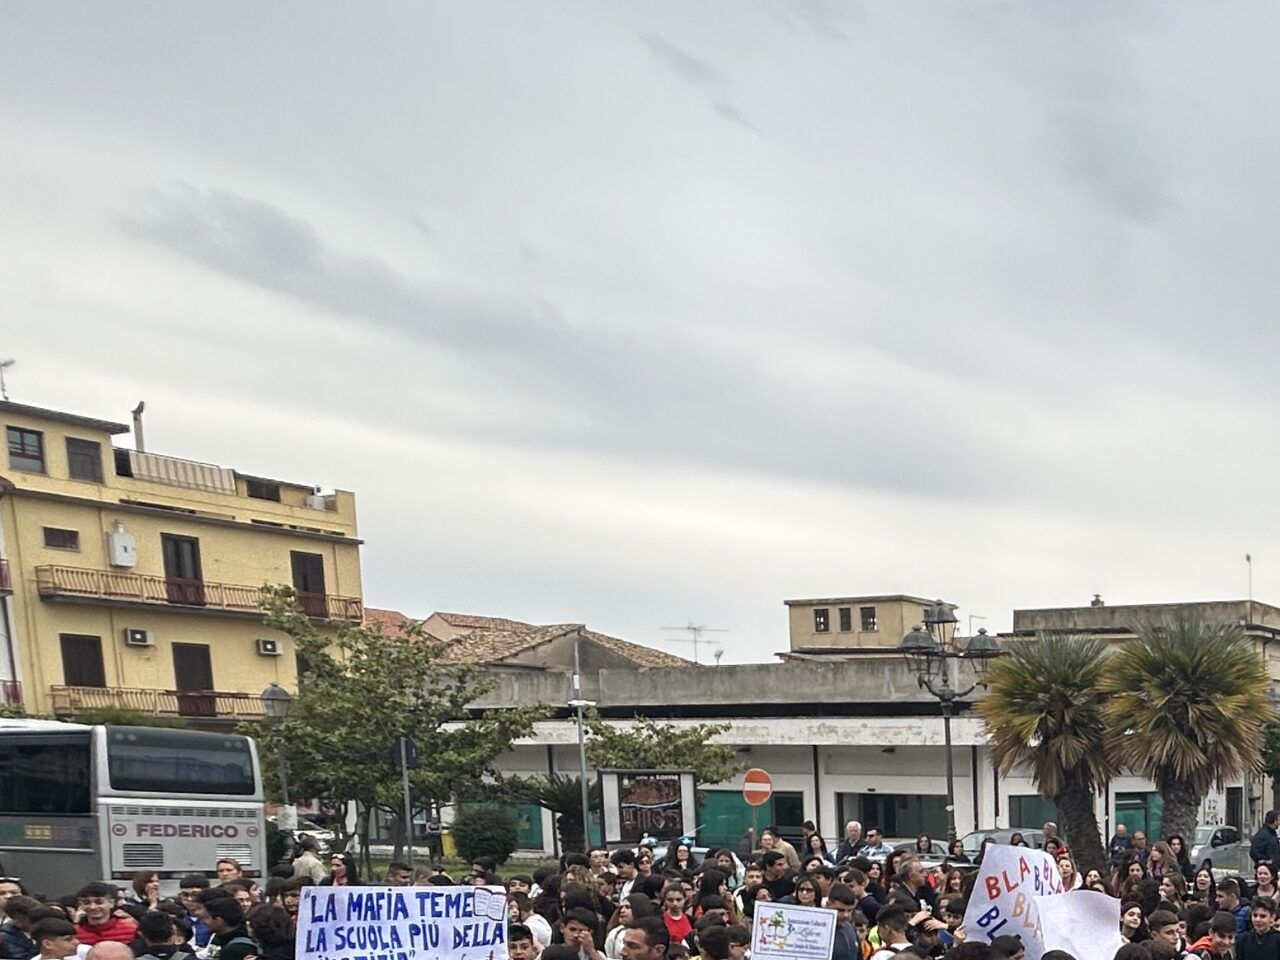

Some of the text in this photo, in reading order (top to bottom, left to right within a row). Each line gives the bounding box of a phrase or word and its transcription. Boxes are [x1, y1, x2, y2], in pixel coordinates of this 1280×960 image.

[136, 824, 239, 838] FEDERICO
[985, 856, 1031, 900] BLA
[416, 892, 475, 919] TEME
[305, 925, 327, 952] LA
[335, 925, 402, 951] SCUOLA
[452, 922, 504, 949] DELLA
[976, 906, 1021, 940] BL
